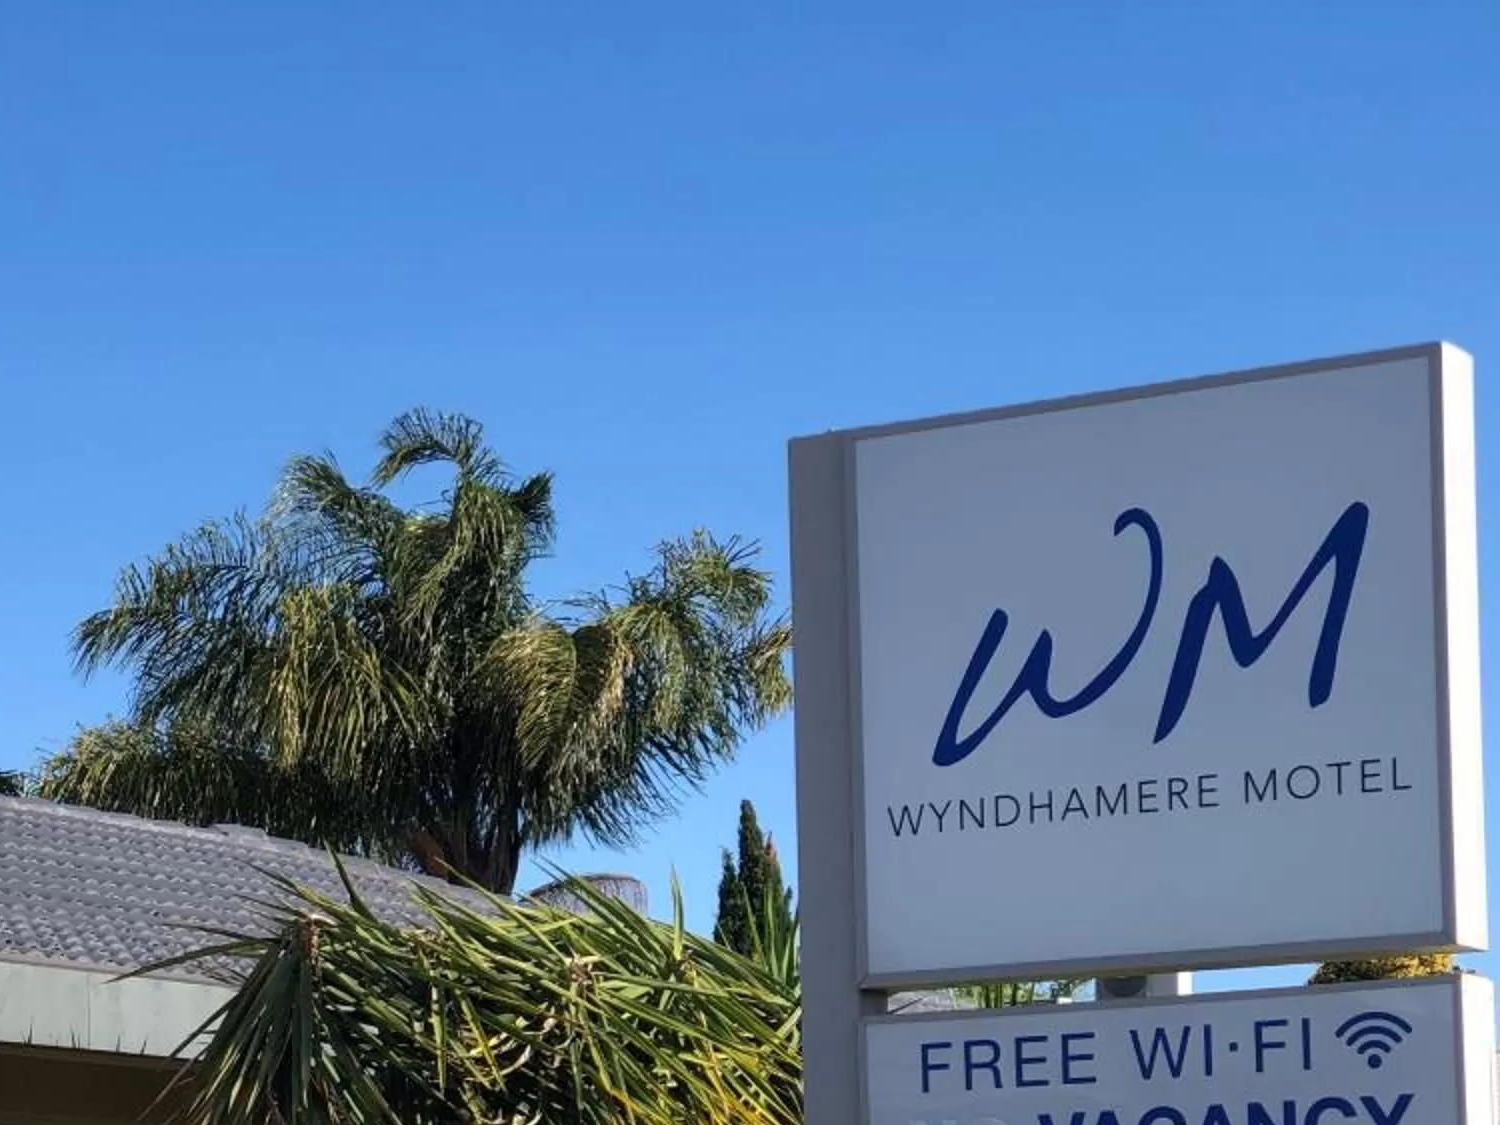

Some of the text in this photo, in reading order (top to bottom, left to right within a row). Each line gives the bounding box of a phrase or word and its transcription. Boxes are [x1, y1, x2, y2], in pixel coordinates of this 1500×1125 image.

[887, 757, 1413, 837] WYNDHAMERE MOTEL
[920, 1031, 1097, 1093] FREE
